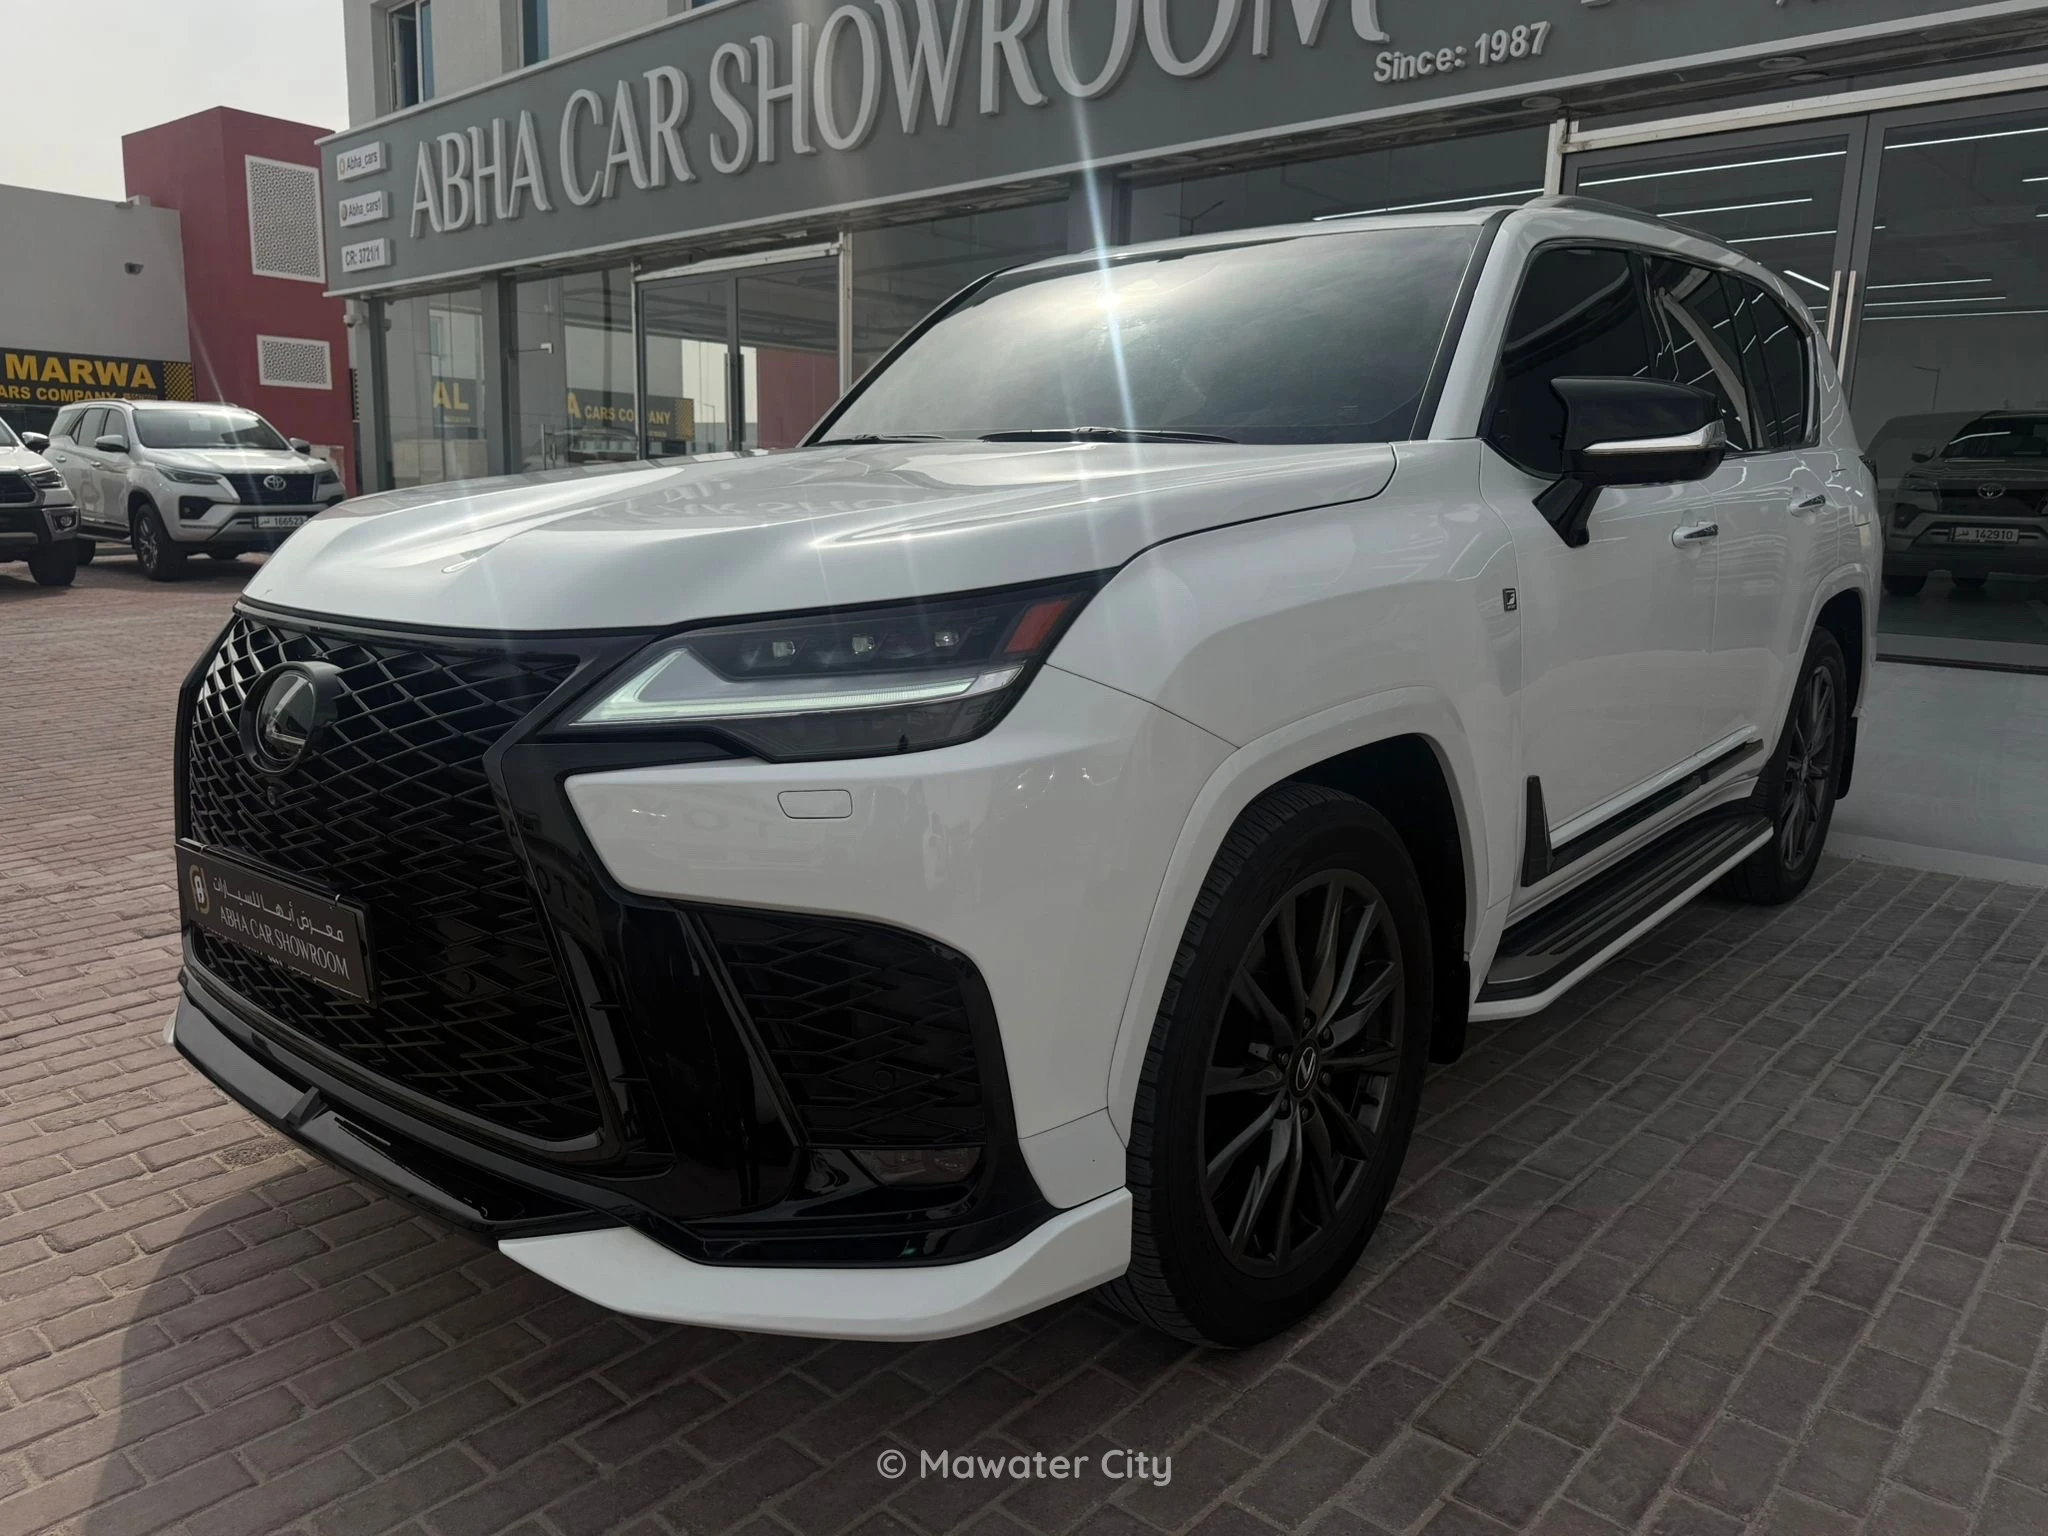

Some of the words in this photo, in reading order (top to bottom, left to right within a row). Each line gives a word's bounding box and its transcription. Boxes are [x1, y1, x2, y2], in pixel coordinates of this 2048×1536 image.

[1372, 44, 1467, 84] Since:
[1473, 21, 1551, 65] 1987
[410, 110, 552, 238] ABHA
[559, 65, 697, 206] CAR
[709, 0, 1389, 175] SHOWRO
[346, 151, 378, 171] Abha_cars
[5, 353, 156, 389] MARWA
[0, 385, 31, 400] ARS
[36, 387, 117, 402] COMPANY
[432, 380, 469, 410] AL
[584, 405, 615, 421] CARS
[618, 408, 671, 425] COANY
[1975, 529, 2014, 540] 142910
[298, 909, 344, 943] معرض
[220, 906, 250, 935] ABHA
[250, 918, 275, 946] CAR
[274, 928, 350, 980] SHOWROOM
